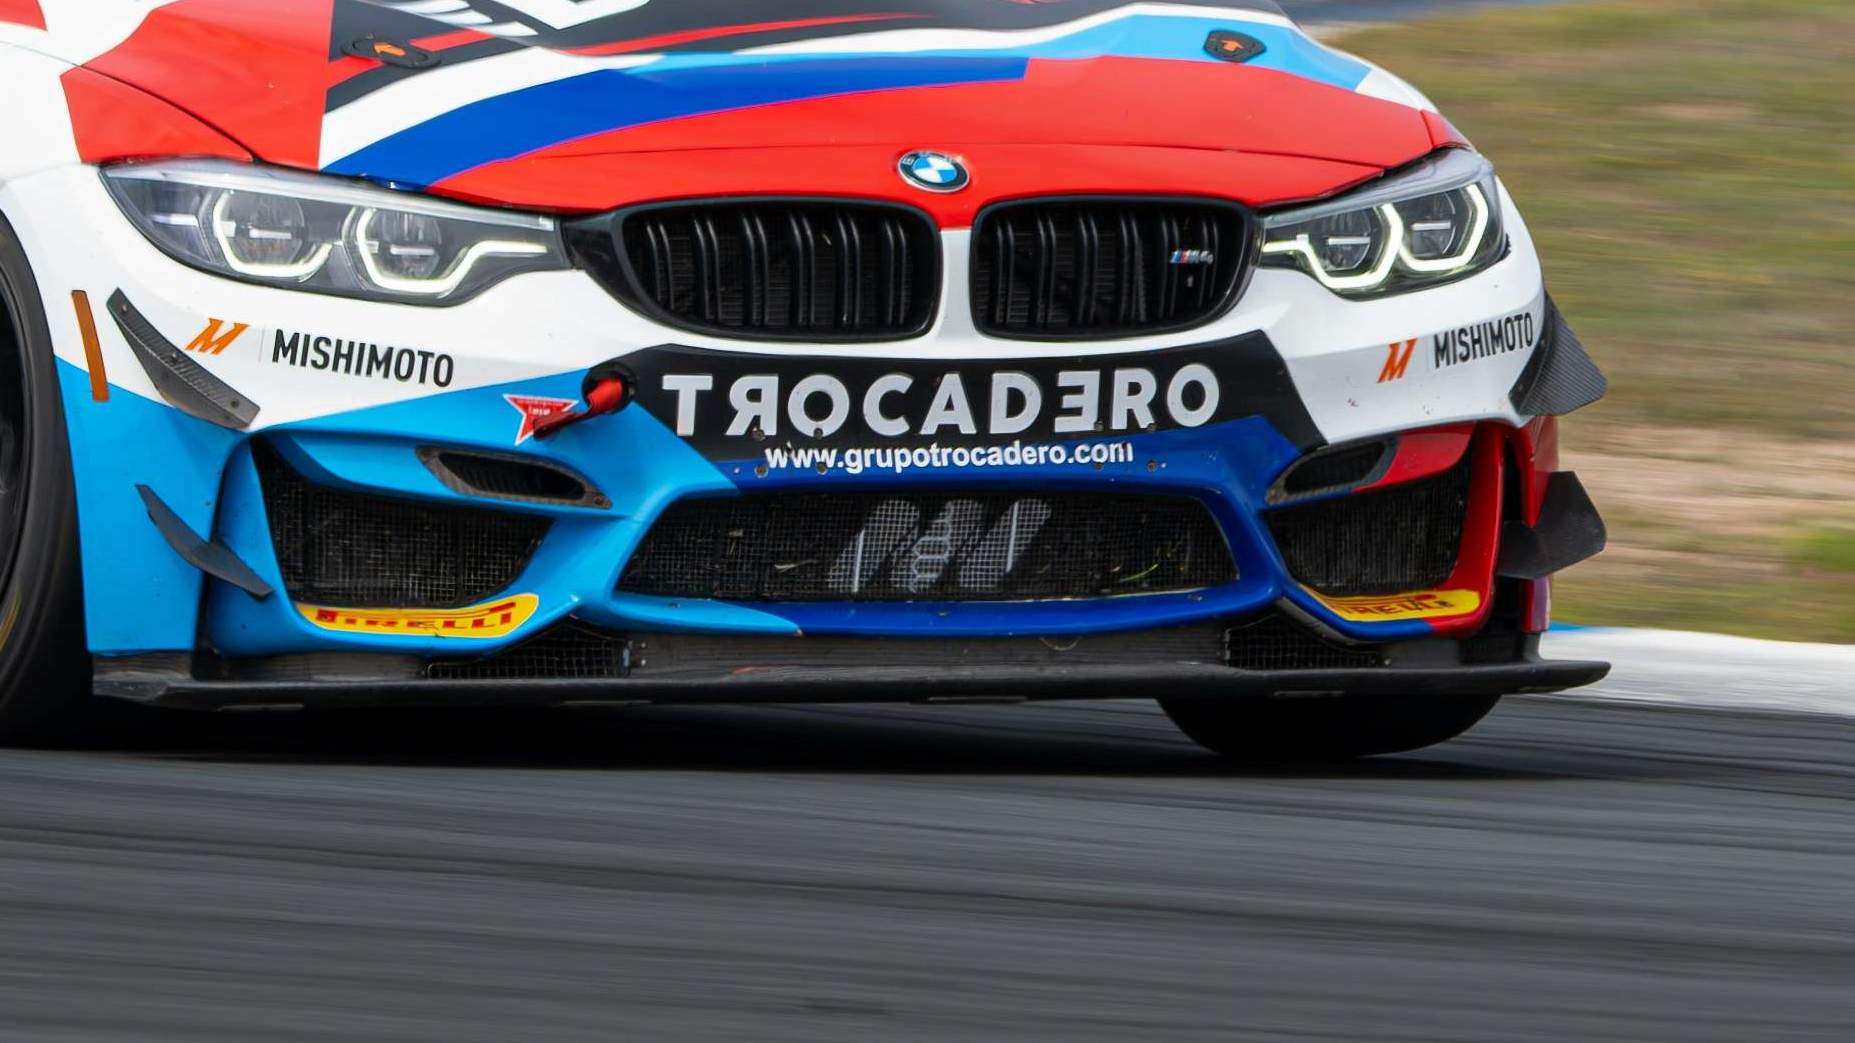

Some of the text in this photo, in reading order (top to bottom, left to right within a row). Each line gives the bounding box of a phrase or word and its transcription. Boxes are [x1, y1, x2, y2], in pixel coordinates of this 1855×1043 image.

[272, 329, 454, 388] MISHIMOTO
[1433, 311, 1534, 369] MISHIMOTO
[765, 440, 1135, 474] www.grupotrocadero.com
